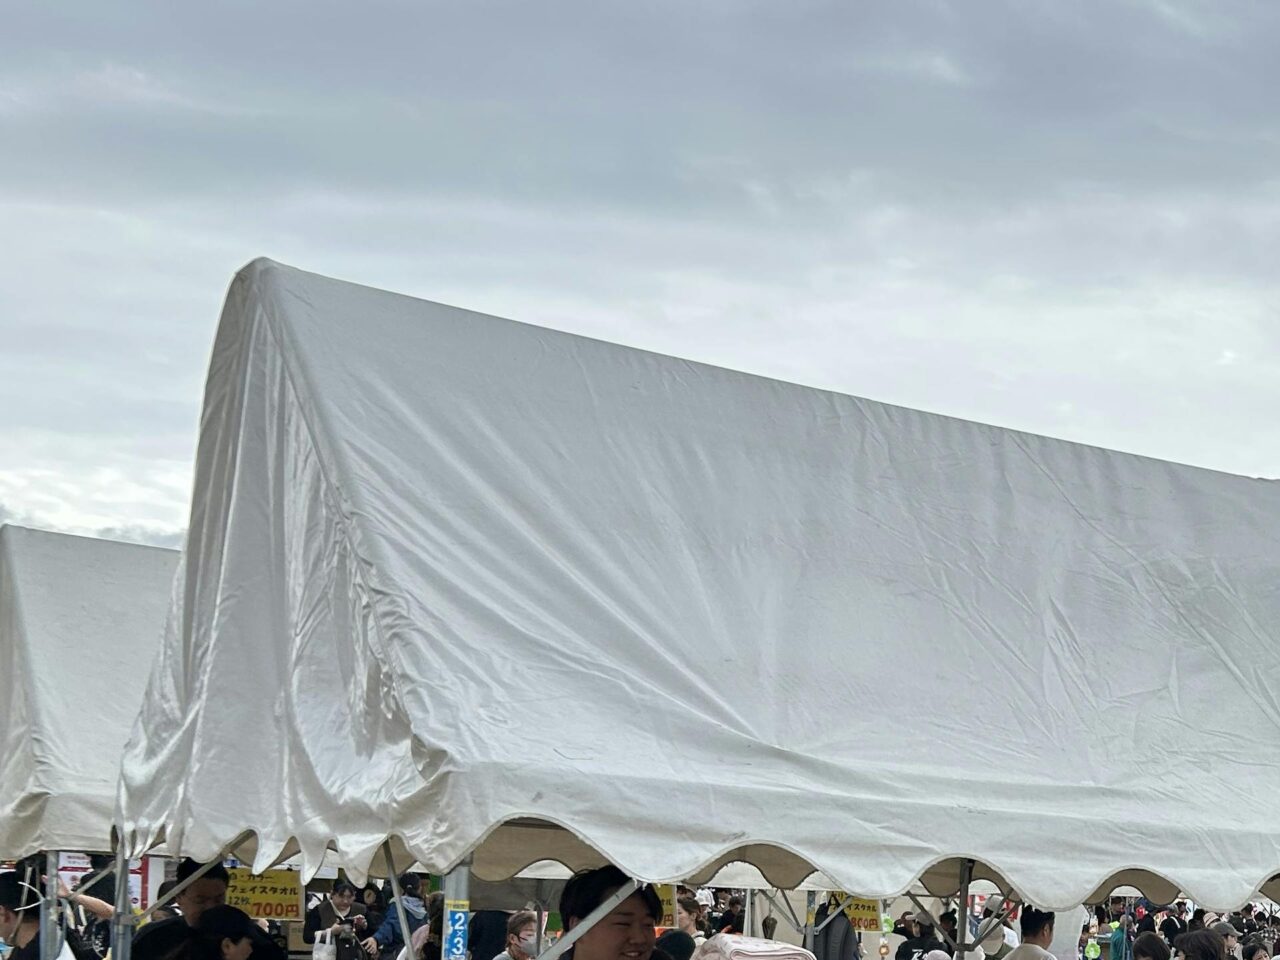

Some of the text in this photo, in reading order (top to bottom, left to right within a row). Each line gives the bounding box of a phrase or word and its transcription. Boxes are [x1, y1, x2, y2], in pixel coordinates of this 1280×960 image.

[226, 885, 298, 896] フェイスタオル
[252, 902, 299, 917] 700円
